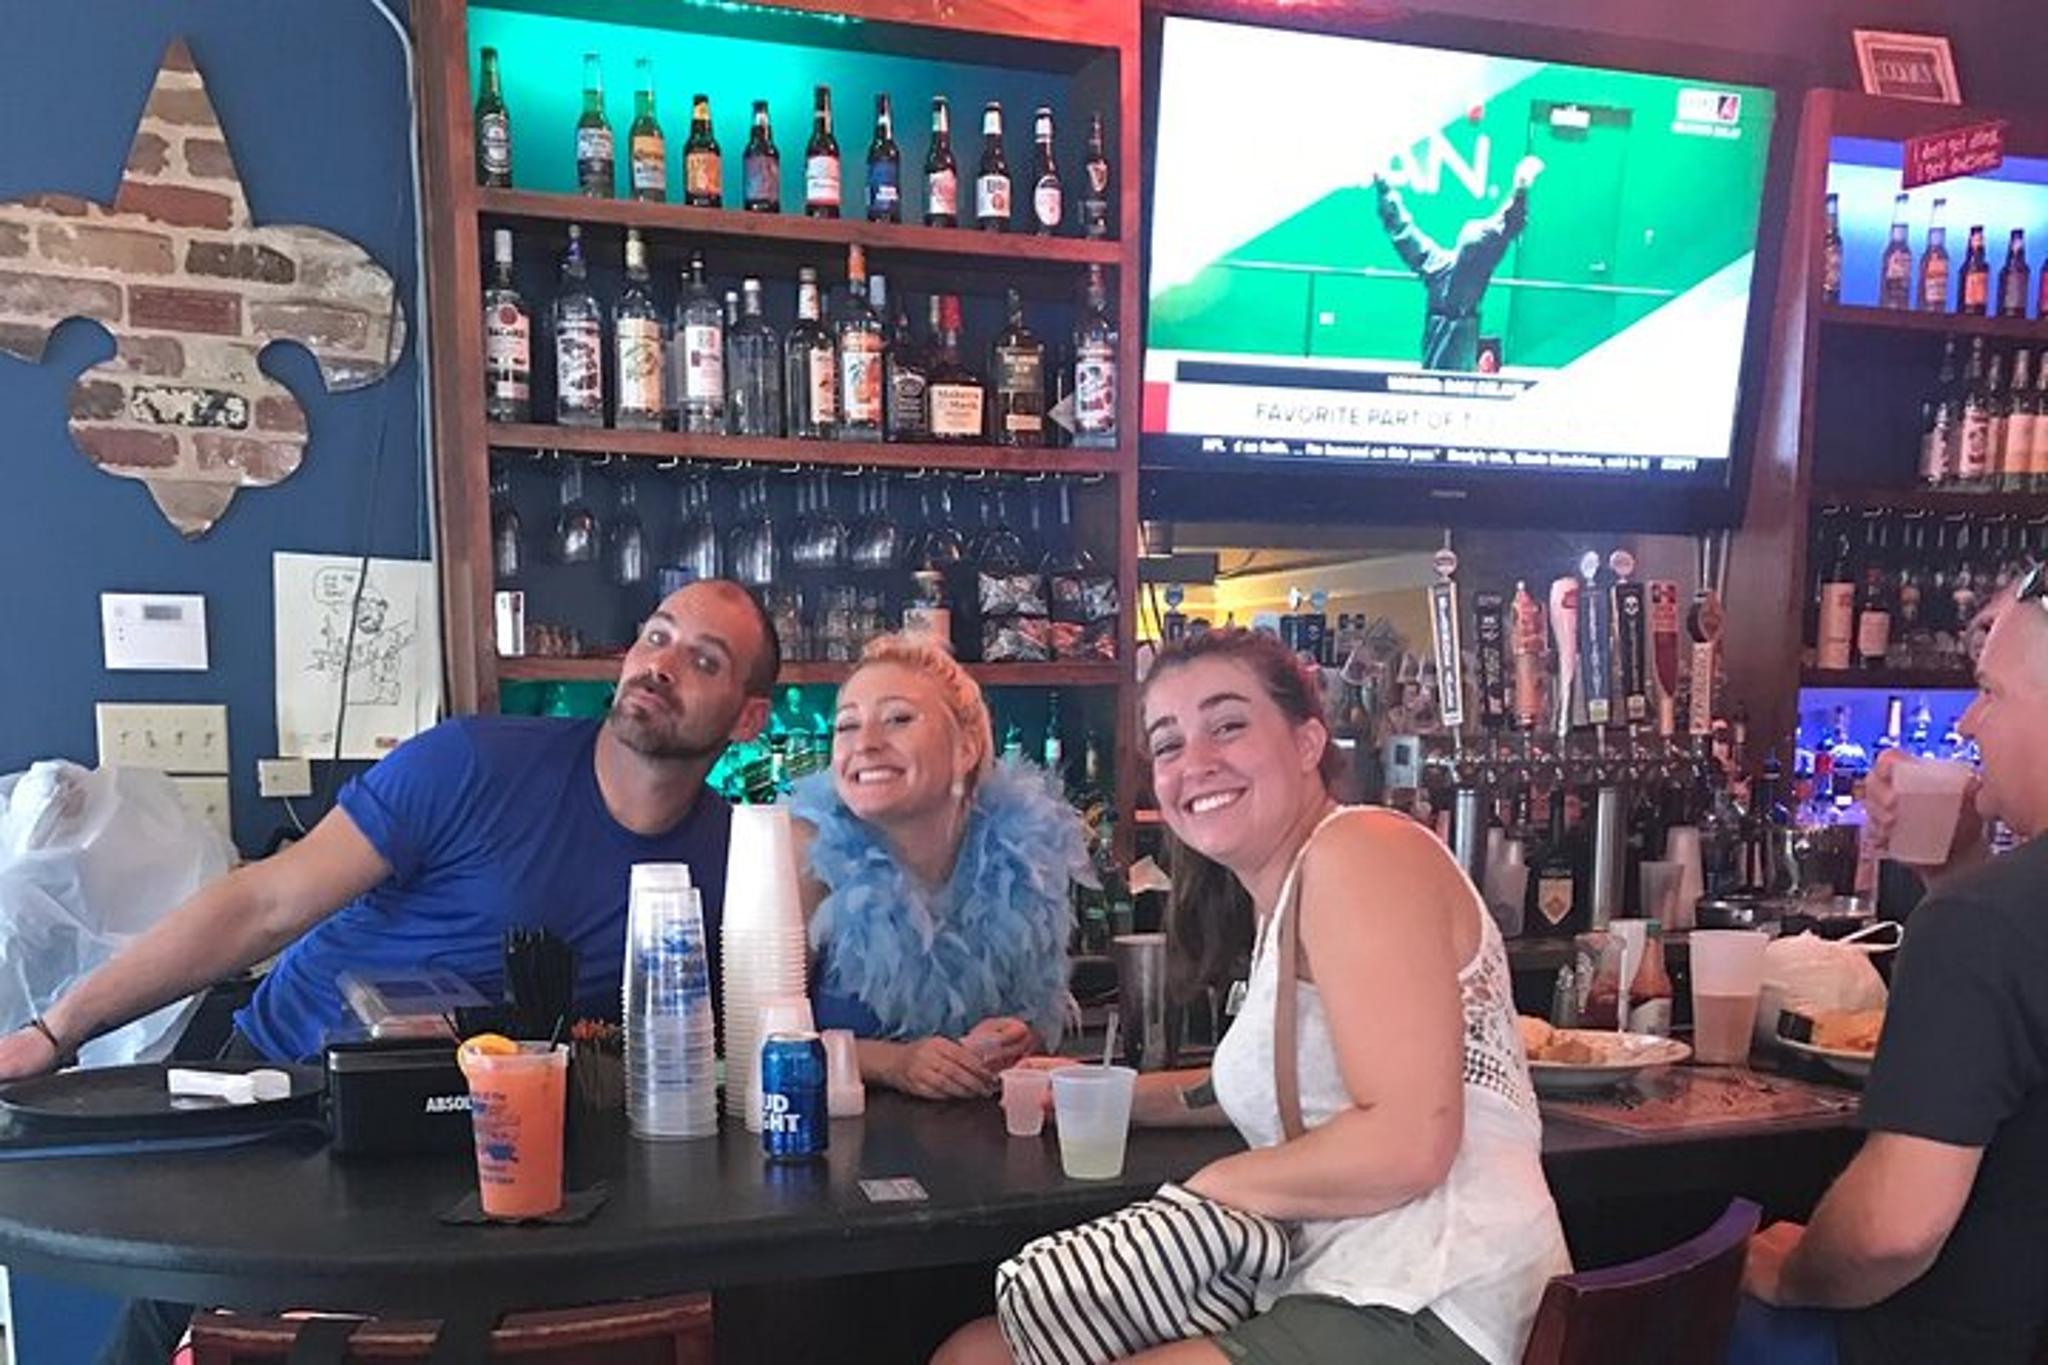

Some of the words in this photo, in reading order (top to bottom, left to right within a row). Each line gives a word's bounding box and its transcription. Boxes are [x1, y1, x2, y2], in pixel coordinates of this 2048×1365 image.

[1256, 402, 1360, 425] FAVORITE
[1368, 406, 1419, 426] PART
[1427, 410, 1453, 429] OF
[426, 1096, 474, 1113] ABSOL
